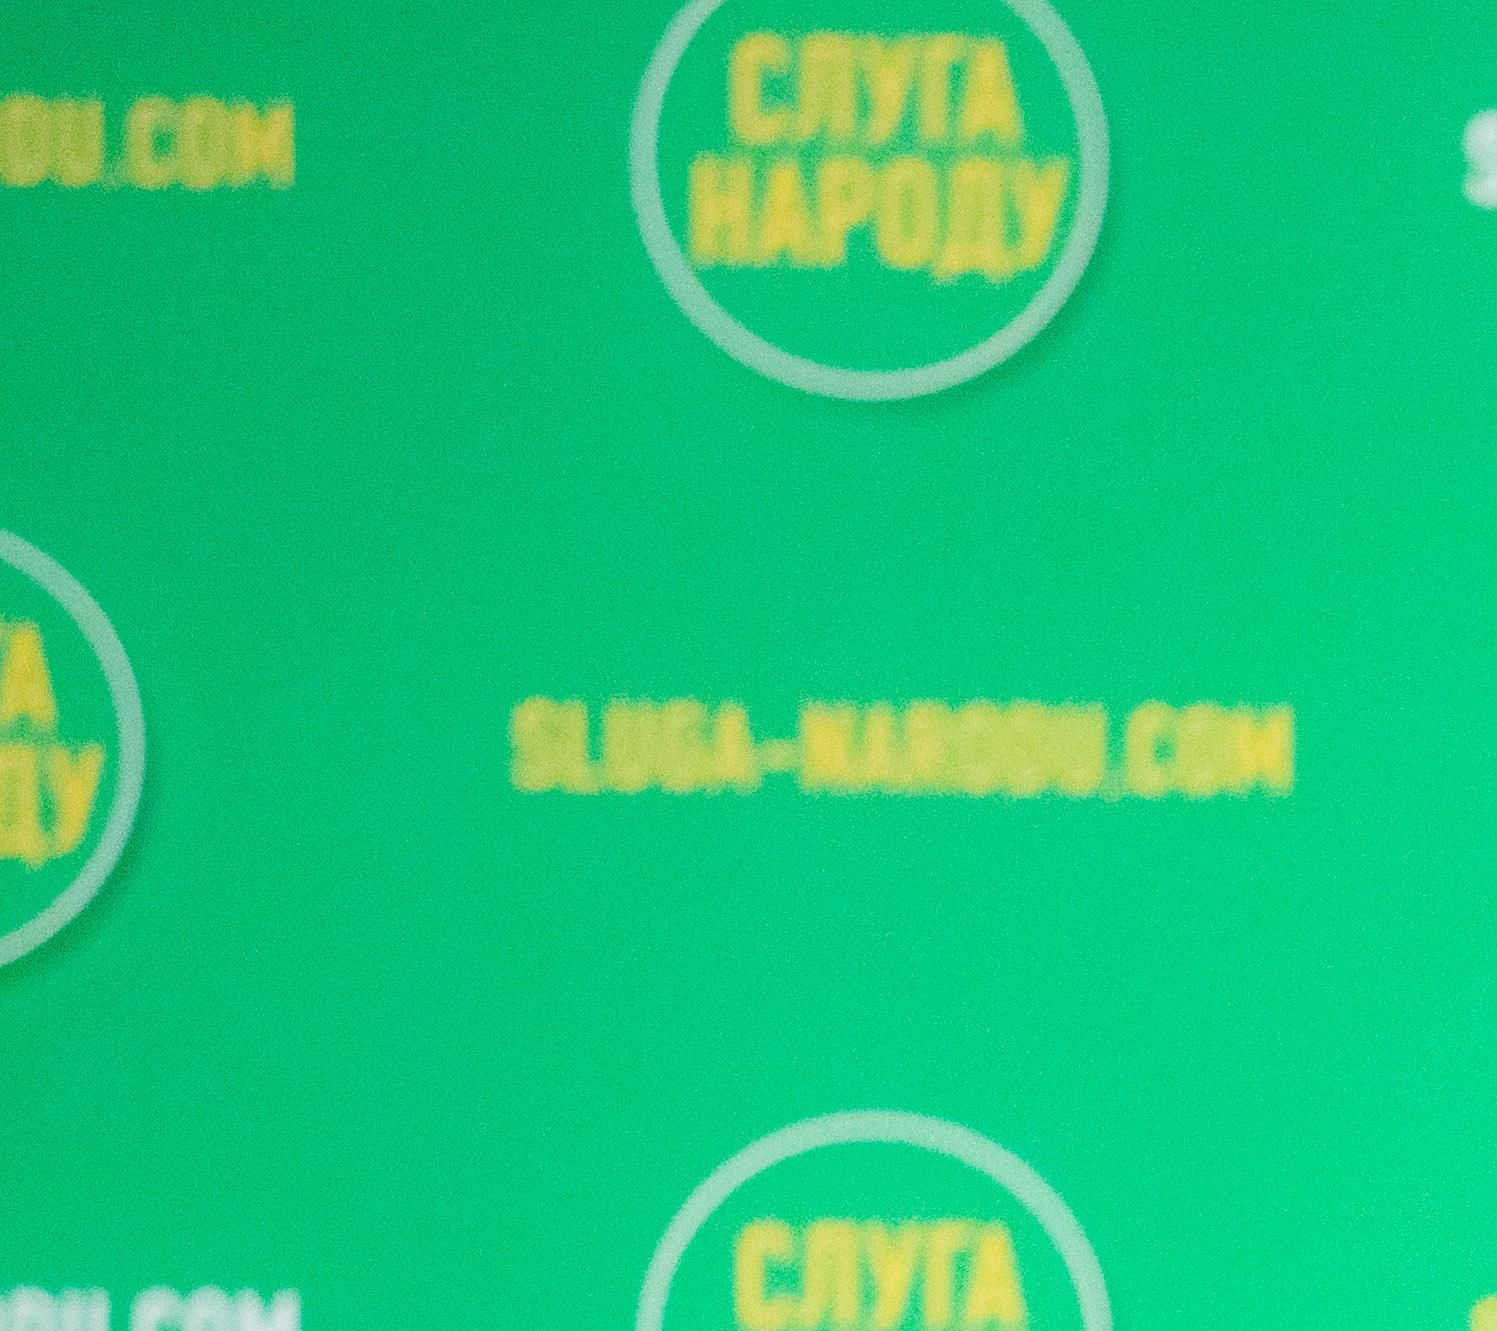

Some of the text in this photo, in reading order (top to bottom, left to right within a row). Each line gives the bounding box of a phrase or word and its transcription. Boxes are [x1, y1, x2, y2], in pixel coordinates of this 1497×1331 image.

[729, 32, 1022, 146] СЛУГА
[689, 148, 1068, 279] НАРОДУ
[511, 700, 1295, 797] SLUGA-NARODU.COM
